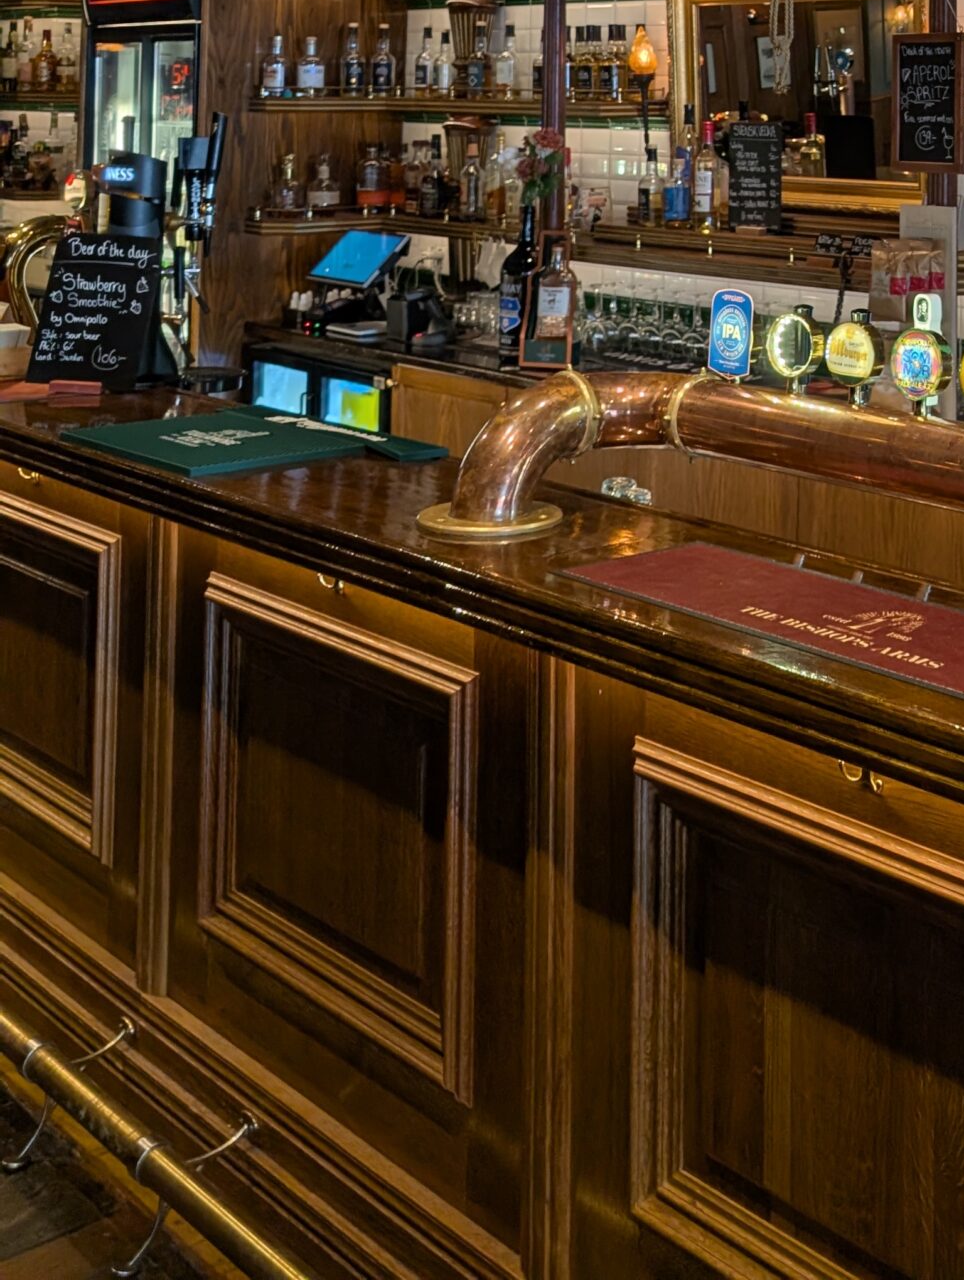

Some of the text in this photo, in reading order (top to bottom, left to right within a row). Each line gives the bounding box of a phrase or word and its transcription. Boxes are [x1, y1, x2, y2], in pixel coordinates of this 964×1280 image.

[68, 237, 97, 257] Beer
[109, 245, 125, 258] the
[127, 245, 157, 269] day
[62, 272, 127, 303] Strawberry
[67, 292, 121, 309] Smoothie
[722, 323, 741, 340] IPA
[740, 606, 783, 621] THE
[781, 618, 874, 649] BISHOPS
[870, 646, 945, 670] ARMS
